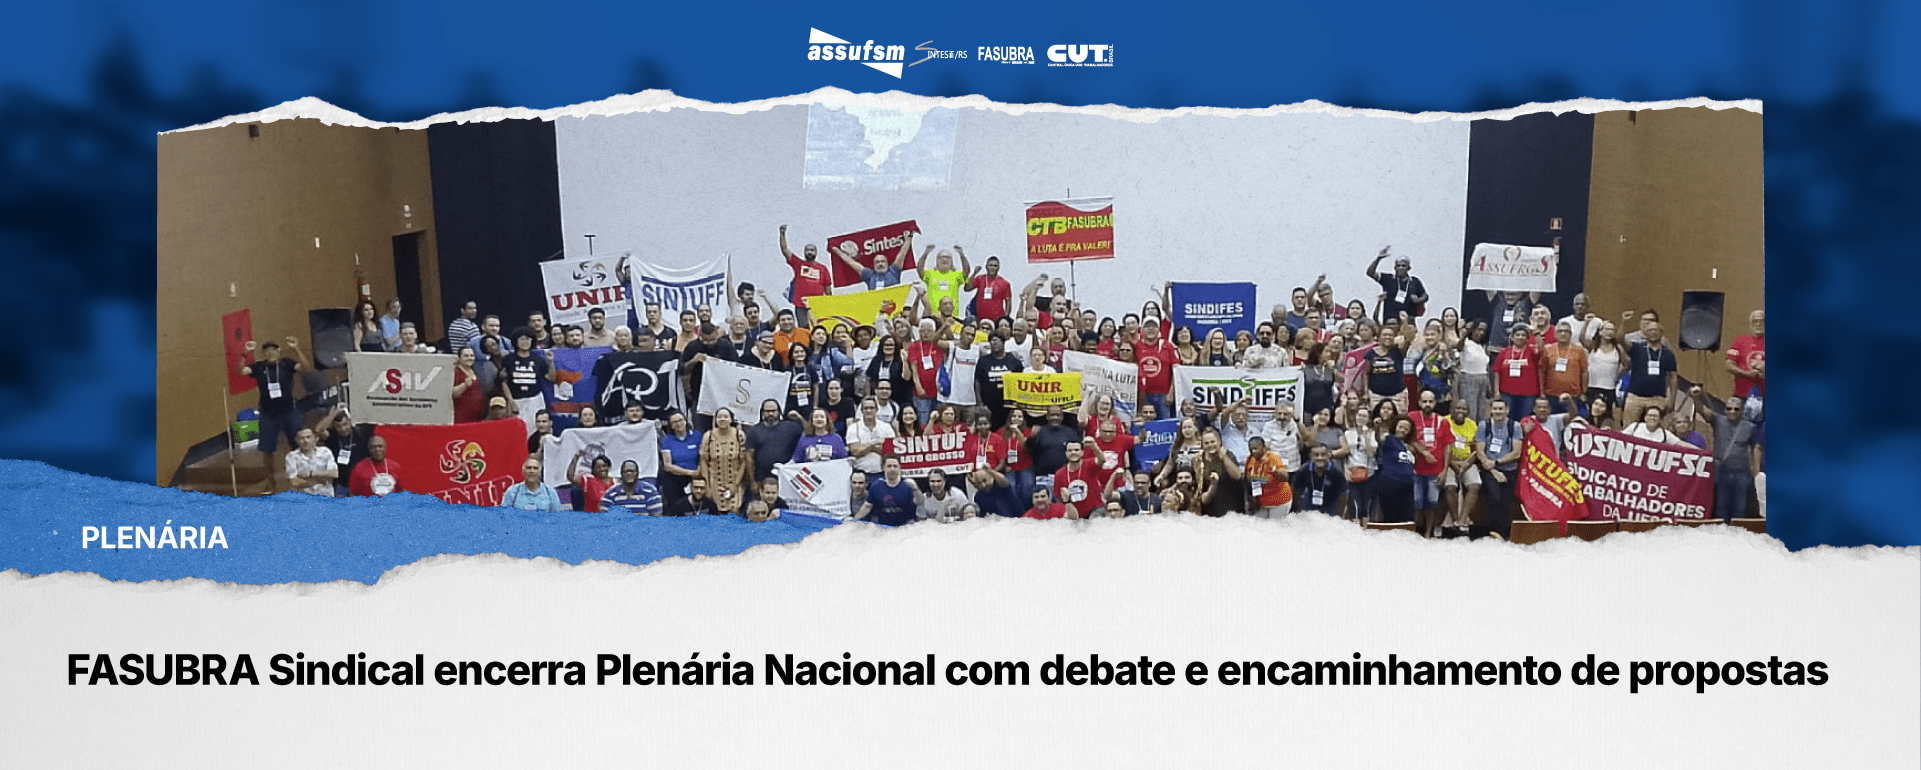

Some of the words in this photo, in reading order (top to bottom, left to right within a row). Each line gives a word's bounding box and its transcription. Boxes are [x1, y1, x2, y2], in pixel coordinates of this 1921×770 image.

[1026, 216, 1067, 236] CTB
[1037, 243, 1058, 253] LUTA
[1065, 242, 1082, 252] PRA
[641, 280, 725, 311] SINTUFF
[1184, 301, 1244, 315] SINDIFES
[1017, 380, 1063, 394] UNIR
[1115, 372, 1136, 385] LUTA
[893, 431, 967, 454] SINTUF
[925, 450, 966, 462] GROSSO
[1590, 434, 1714, 479] SINTUFSC
[1647, 483, 1668, 499] DE
[1582, 483, 1706, 519] ABALHADORES
[1602, 503, 1621, 522] DA
